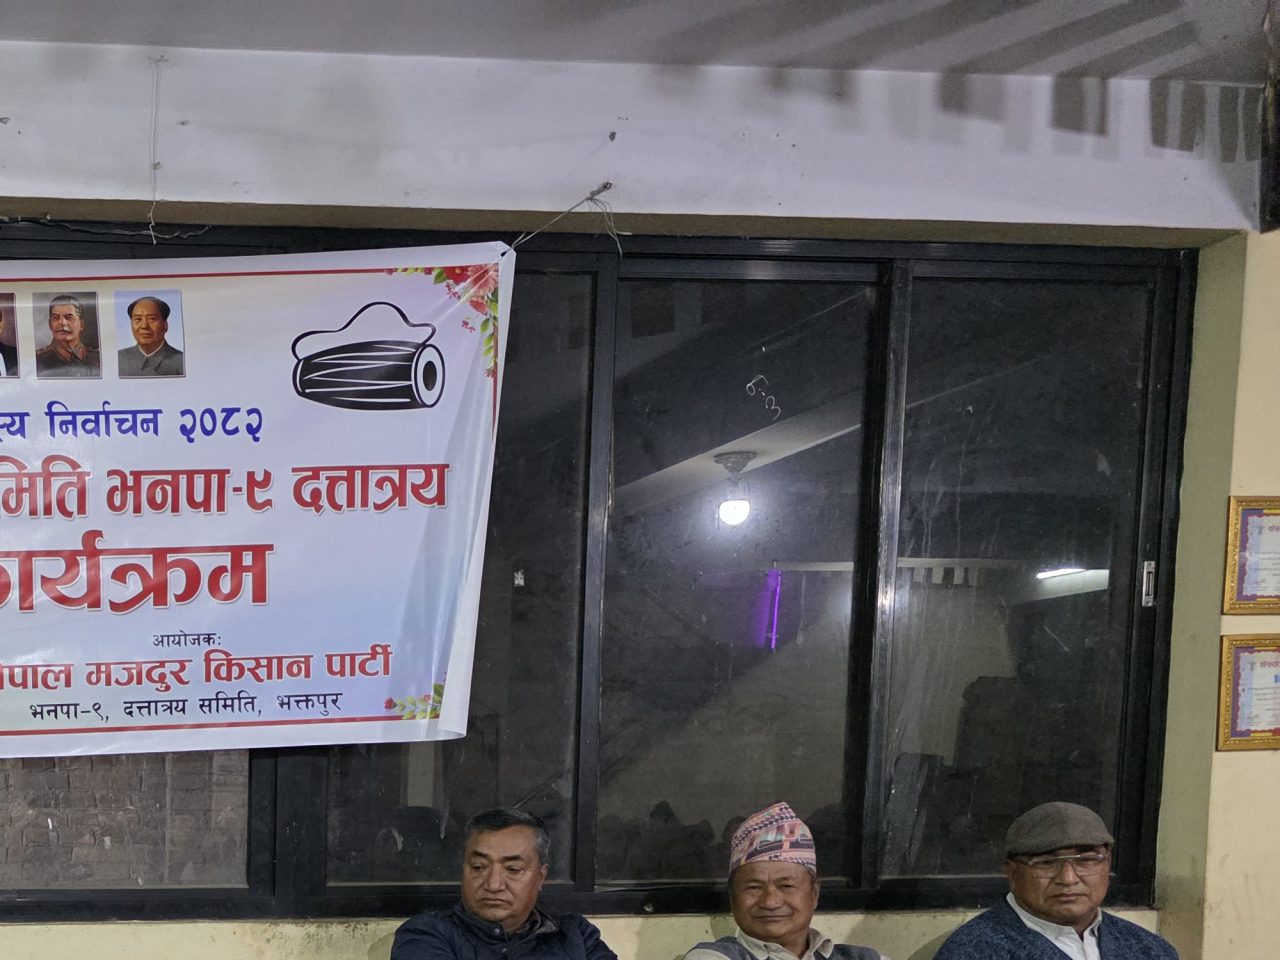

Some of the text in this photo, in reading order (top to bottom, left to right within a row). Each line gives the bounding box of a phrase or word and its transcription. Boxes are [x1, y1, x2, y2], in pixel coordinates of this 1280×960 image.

[45, 400, 163, 438] निर्वाचन
[179, 406, 263, 443] २०८२
[106, 467, 274, 518] भनपा-९
[292, 463, 450, 514] दत्तात्रय
[85, 659, 193, 693] मजदुर
[204, 648, 314, 684] किसान
[324, 643, 393, 678] पार्टी
[123, 697, 187, 718] दत्तात्रय
[199, 692, 261, 718] समिति,
[276, 691, 343, 718] भक्तपुर
